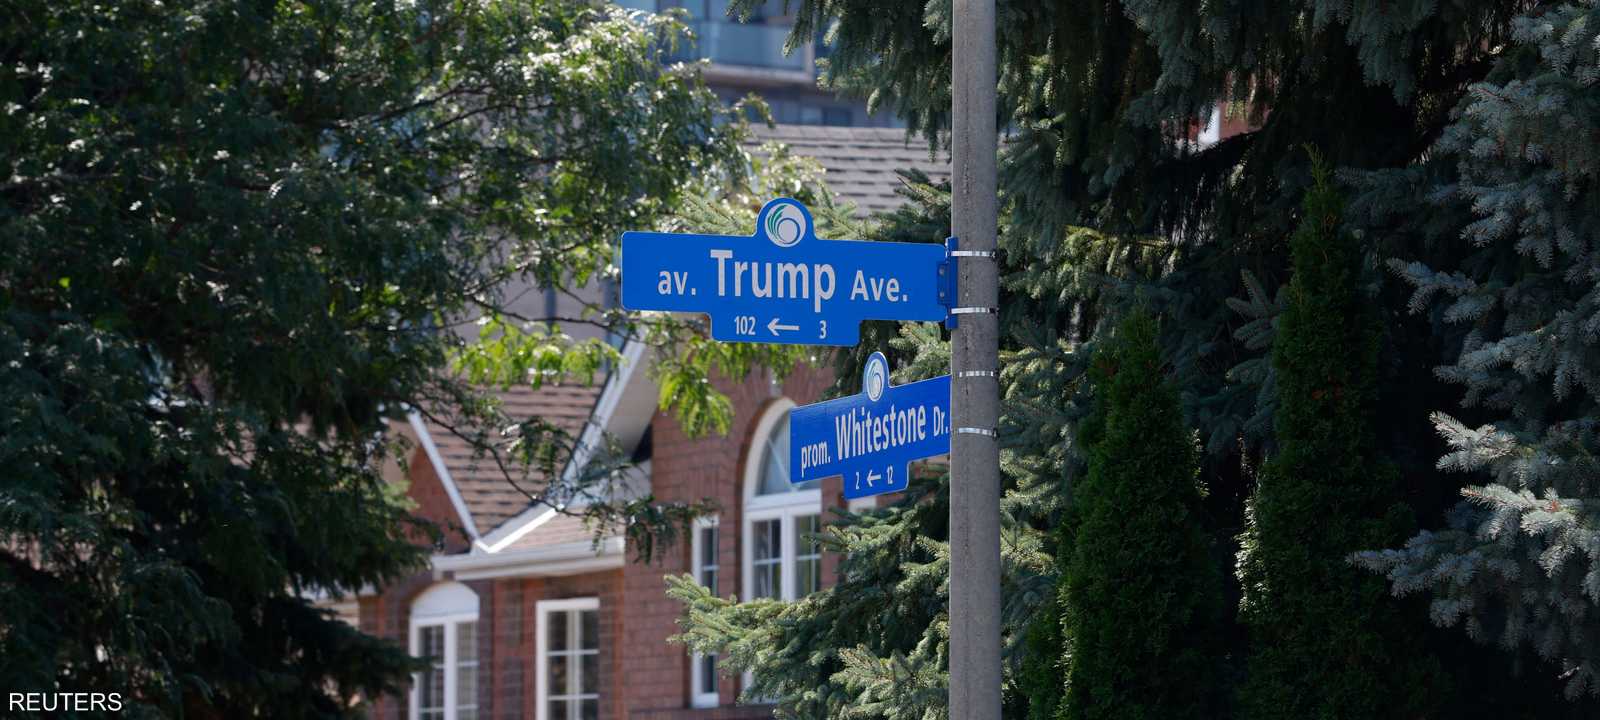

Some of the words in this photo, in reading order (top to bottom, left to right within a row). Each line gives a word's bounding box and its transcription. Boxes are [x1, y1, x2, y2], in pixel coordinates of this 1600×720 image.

[657, 270, 696, 296] av.
[710, 249, 836, 313] Trump
[850, 270, 908, 302] Ave.
[734, 316, 756, 336] 102
[819, 320, 827, 339] 3
[801, 440, 831, 478] prom.
[835, 404, 927, 461] Whitestone
[933, 406, 949, 436] Dr.
[855, 471, 860, 490] 2
[887, 464, 894, 485] 12
